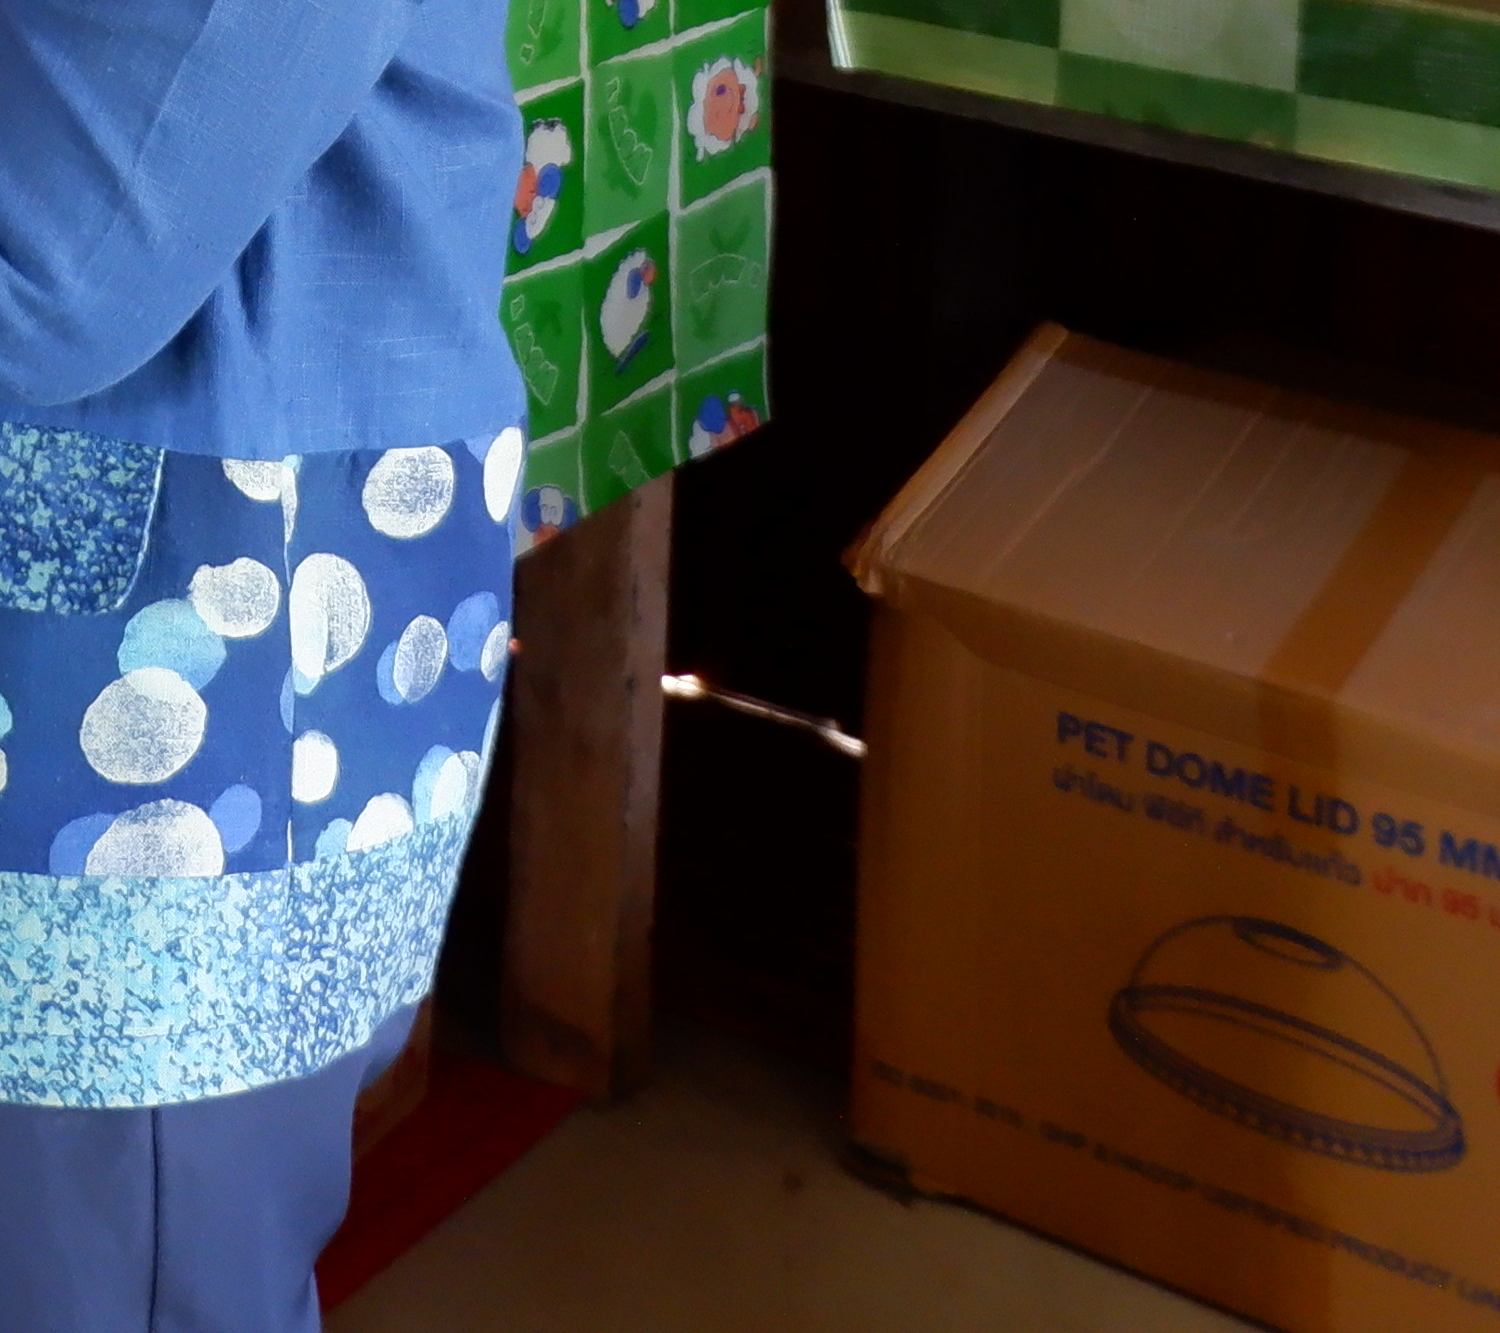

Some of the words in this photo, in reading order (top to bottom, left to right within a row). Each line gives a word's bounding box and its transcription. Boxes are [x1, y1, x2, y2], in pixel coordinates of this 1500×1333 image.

[1057, 711, 1134, 764] PET
[1145, 740, 1275, 811] DOME
[1288, 785, 1360, 836] LID
[1372, 811, 1425, 857] 95
